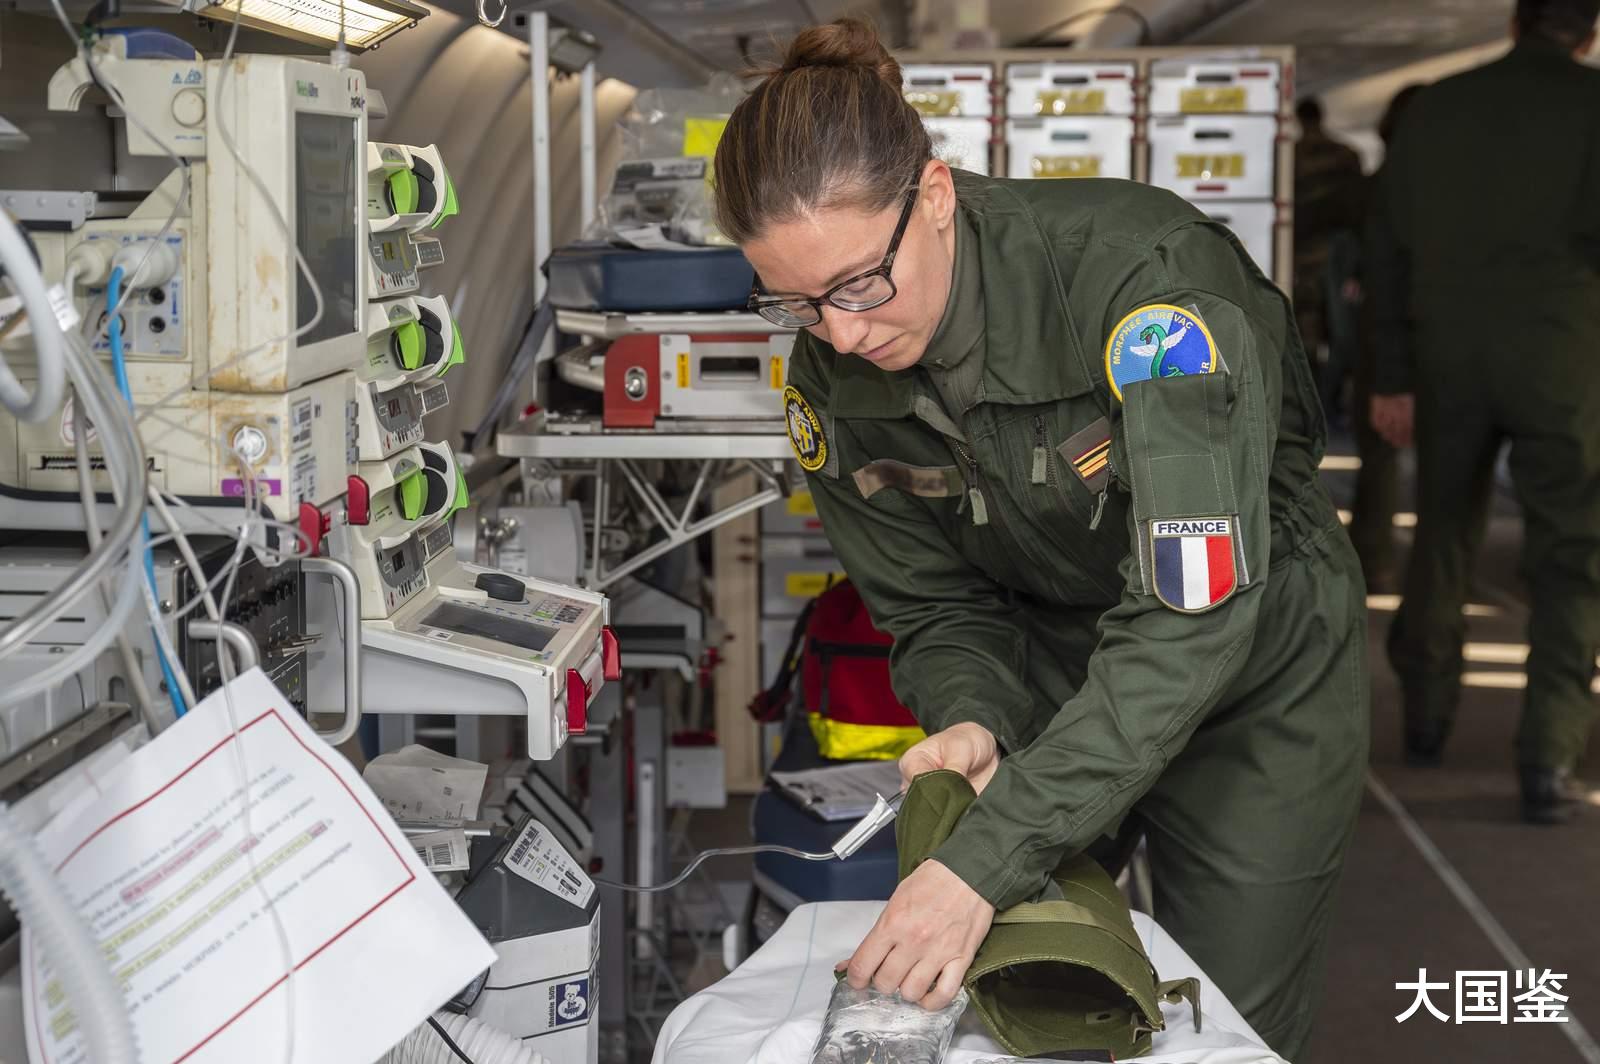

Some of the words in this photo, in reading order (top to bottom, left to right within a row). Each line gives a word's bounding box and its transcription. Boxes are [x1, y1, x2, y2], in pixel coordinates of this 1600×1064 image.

[1113, 317, 1143, 365] MORPHEE
[1147, 312, 1194, 329] AIREVAC
[1158, 522, 1226, 534] FRANCE
